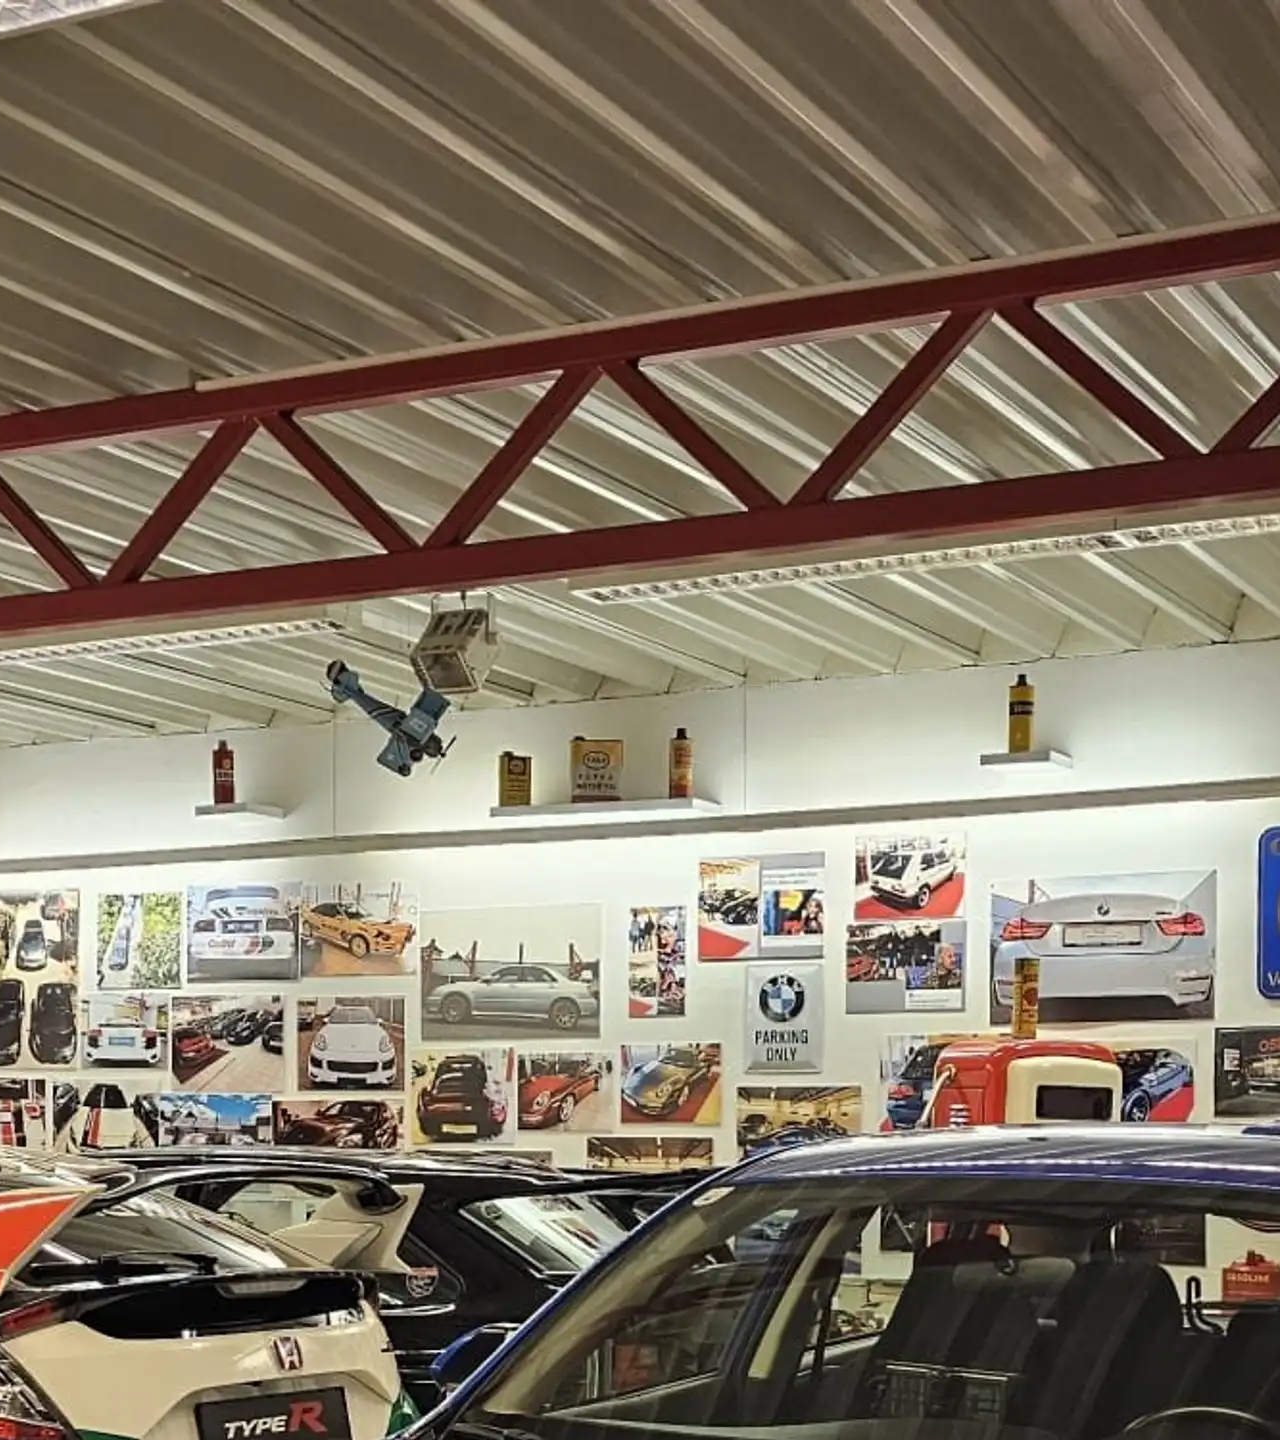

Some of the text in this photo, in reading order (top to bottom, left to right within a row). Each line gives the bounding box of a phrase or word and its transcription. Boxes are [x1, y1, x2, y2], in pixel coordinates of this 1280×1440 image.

[755, 1029, 809, 1045] PARKING
[766, 1047, 797, 1062] ONLY
[224, 1400, 328, 1440] TYPE R
